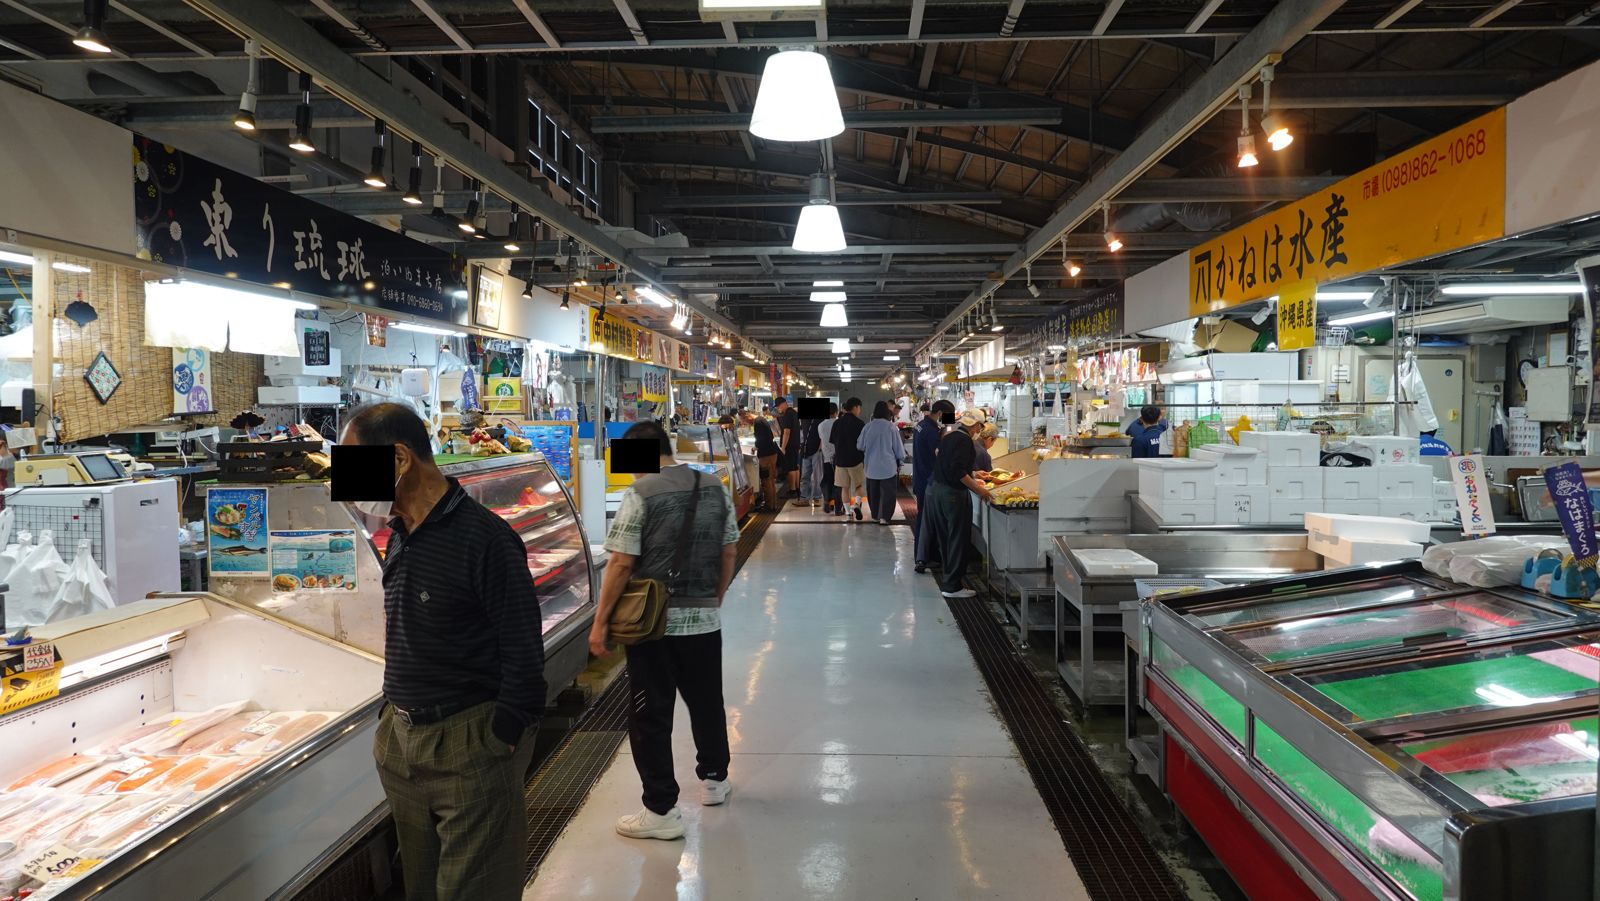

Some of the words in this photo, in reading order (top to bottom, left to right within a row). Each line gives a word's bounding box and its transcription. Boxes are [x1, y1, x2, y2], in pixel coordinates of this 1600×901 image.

[1382, 128, 1487, 193] (098)862-1068
[1279, 298, 1314, 330] 沖縄県産
[1564, 497, 1590, 556] なはまぐろ
